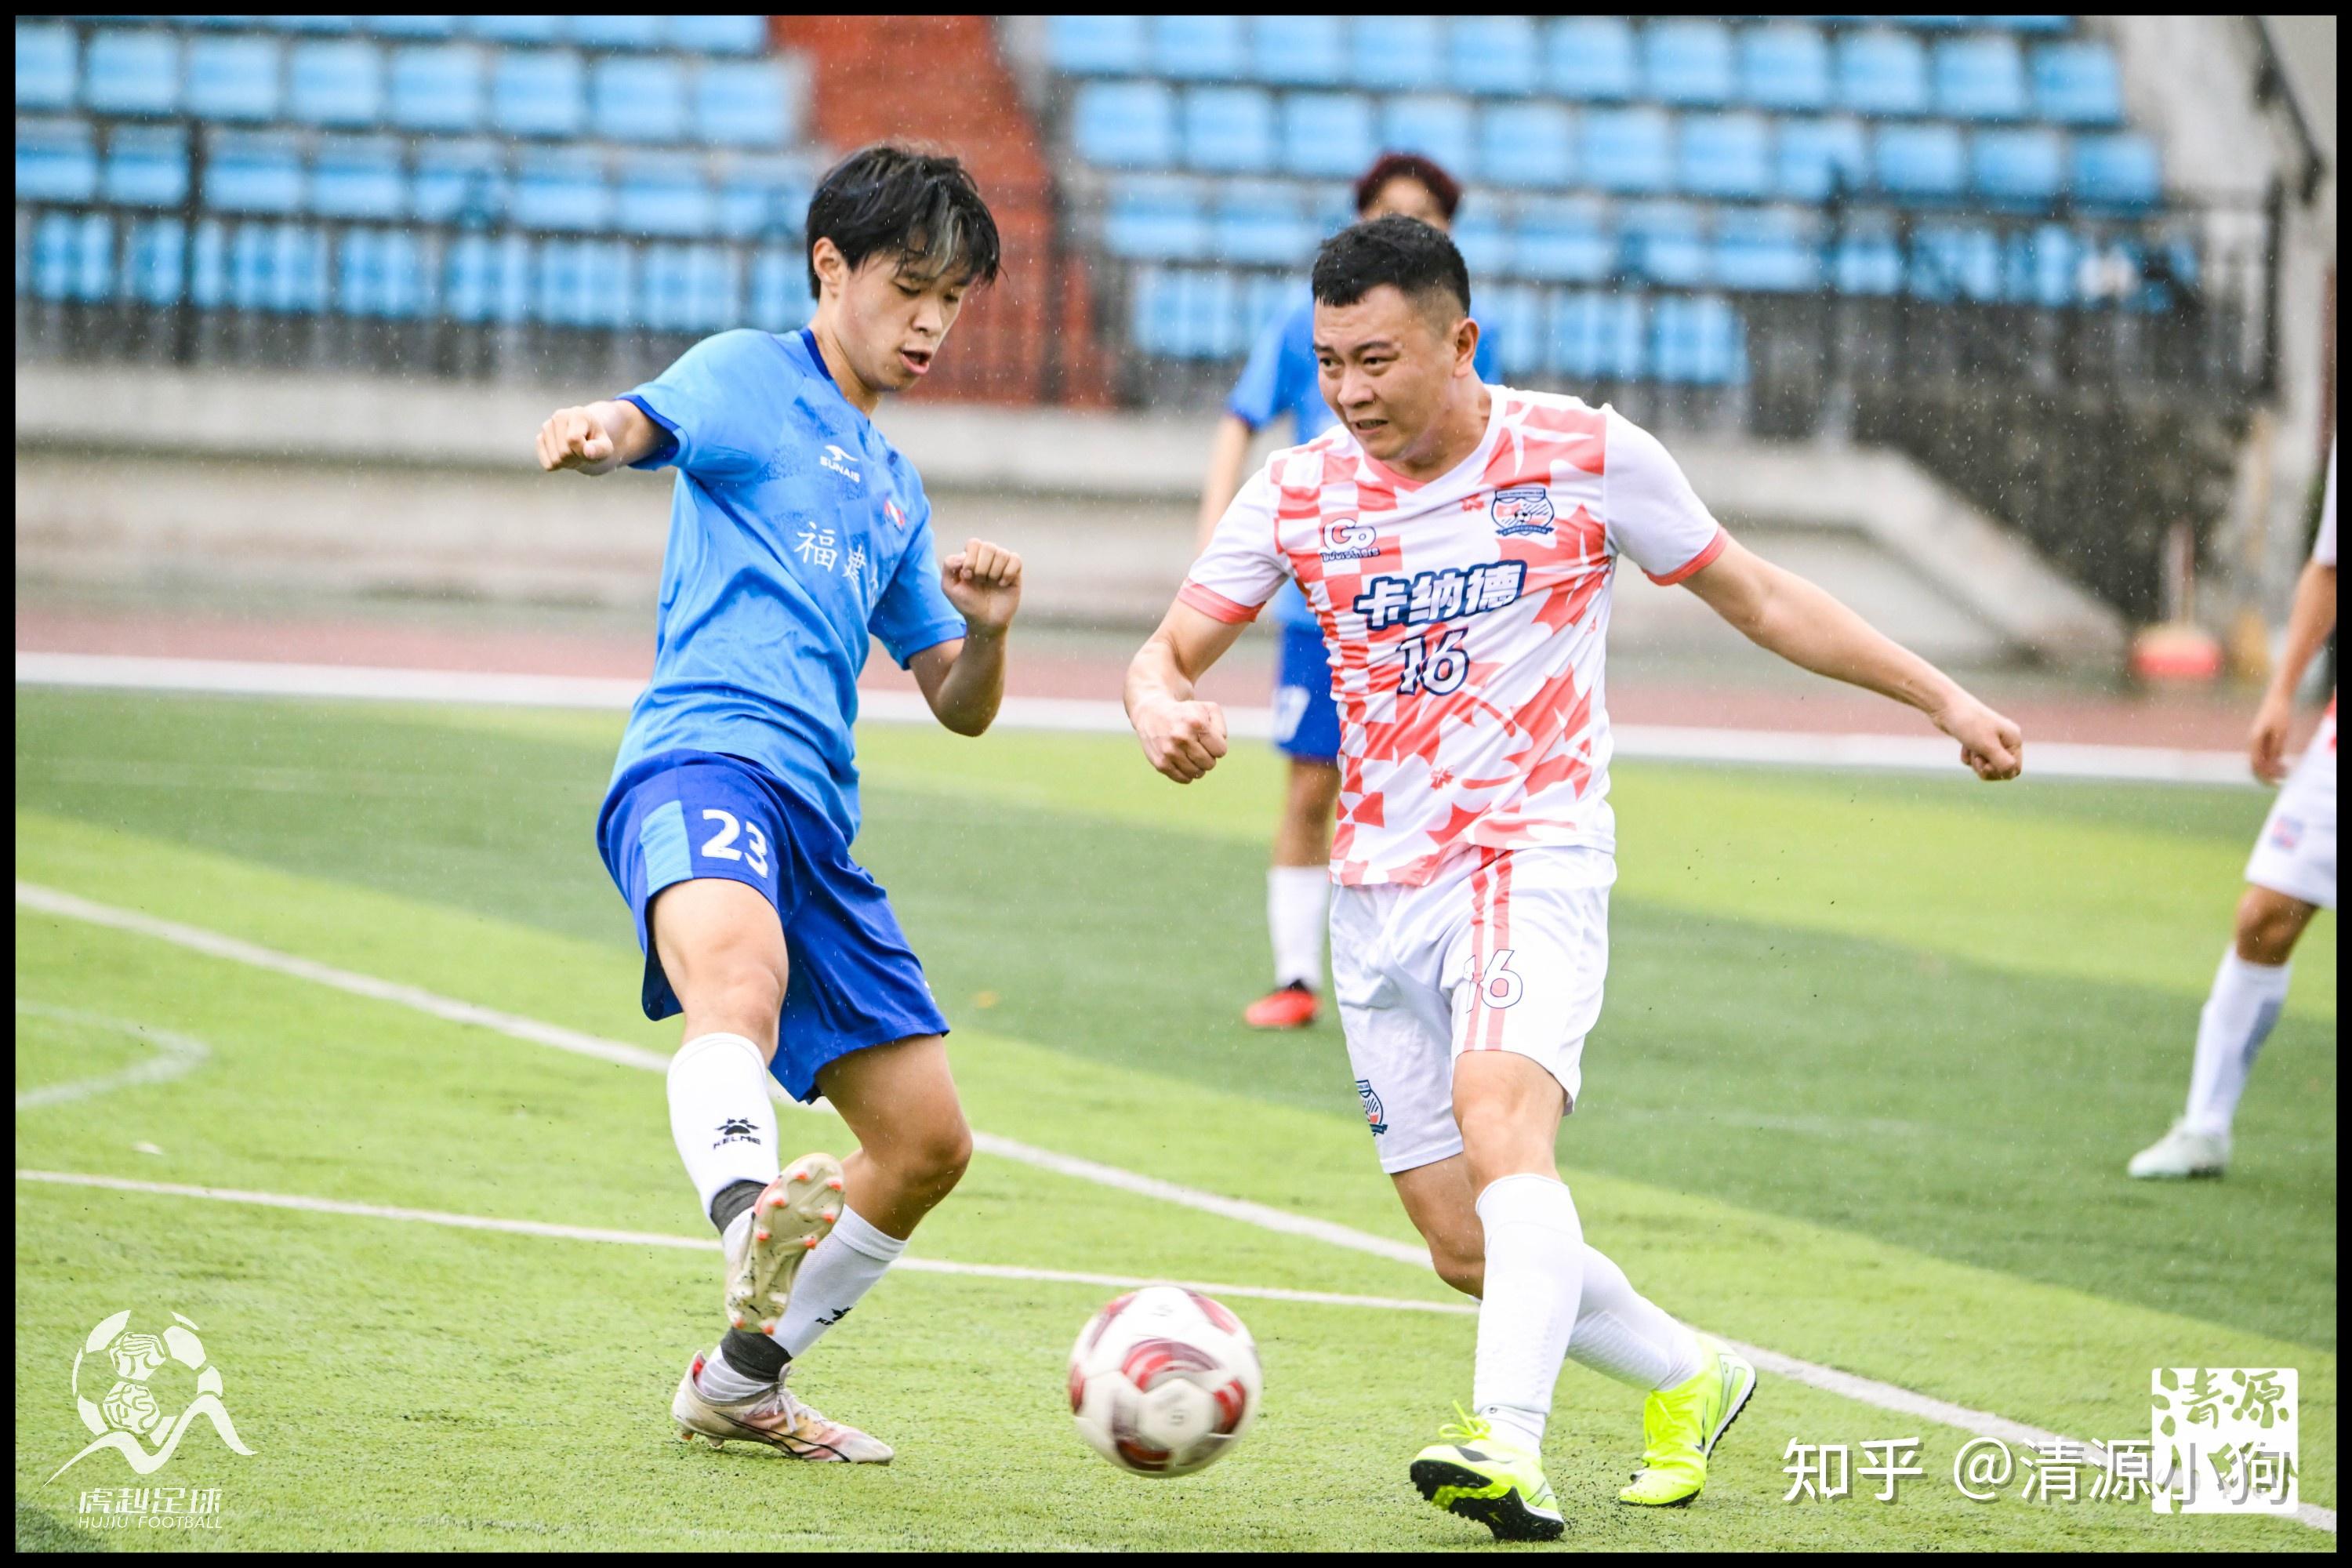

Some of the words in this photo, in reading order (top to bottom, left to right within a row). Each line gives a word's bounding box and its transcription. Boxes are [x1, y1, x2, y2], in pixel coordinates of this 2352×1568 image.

[1353, 560, 1527, 630] 卡纳德
[1396, 628, 1470, 695] 16
[701, 809, 769, 879] 23
[1463, 949, 1523, 1014] 16
[713, 1136, 761, 1149] KELME
